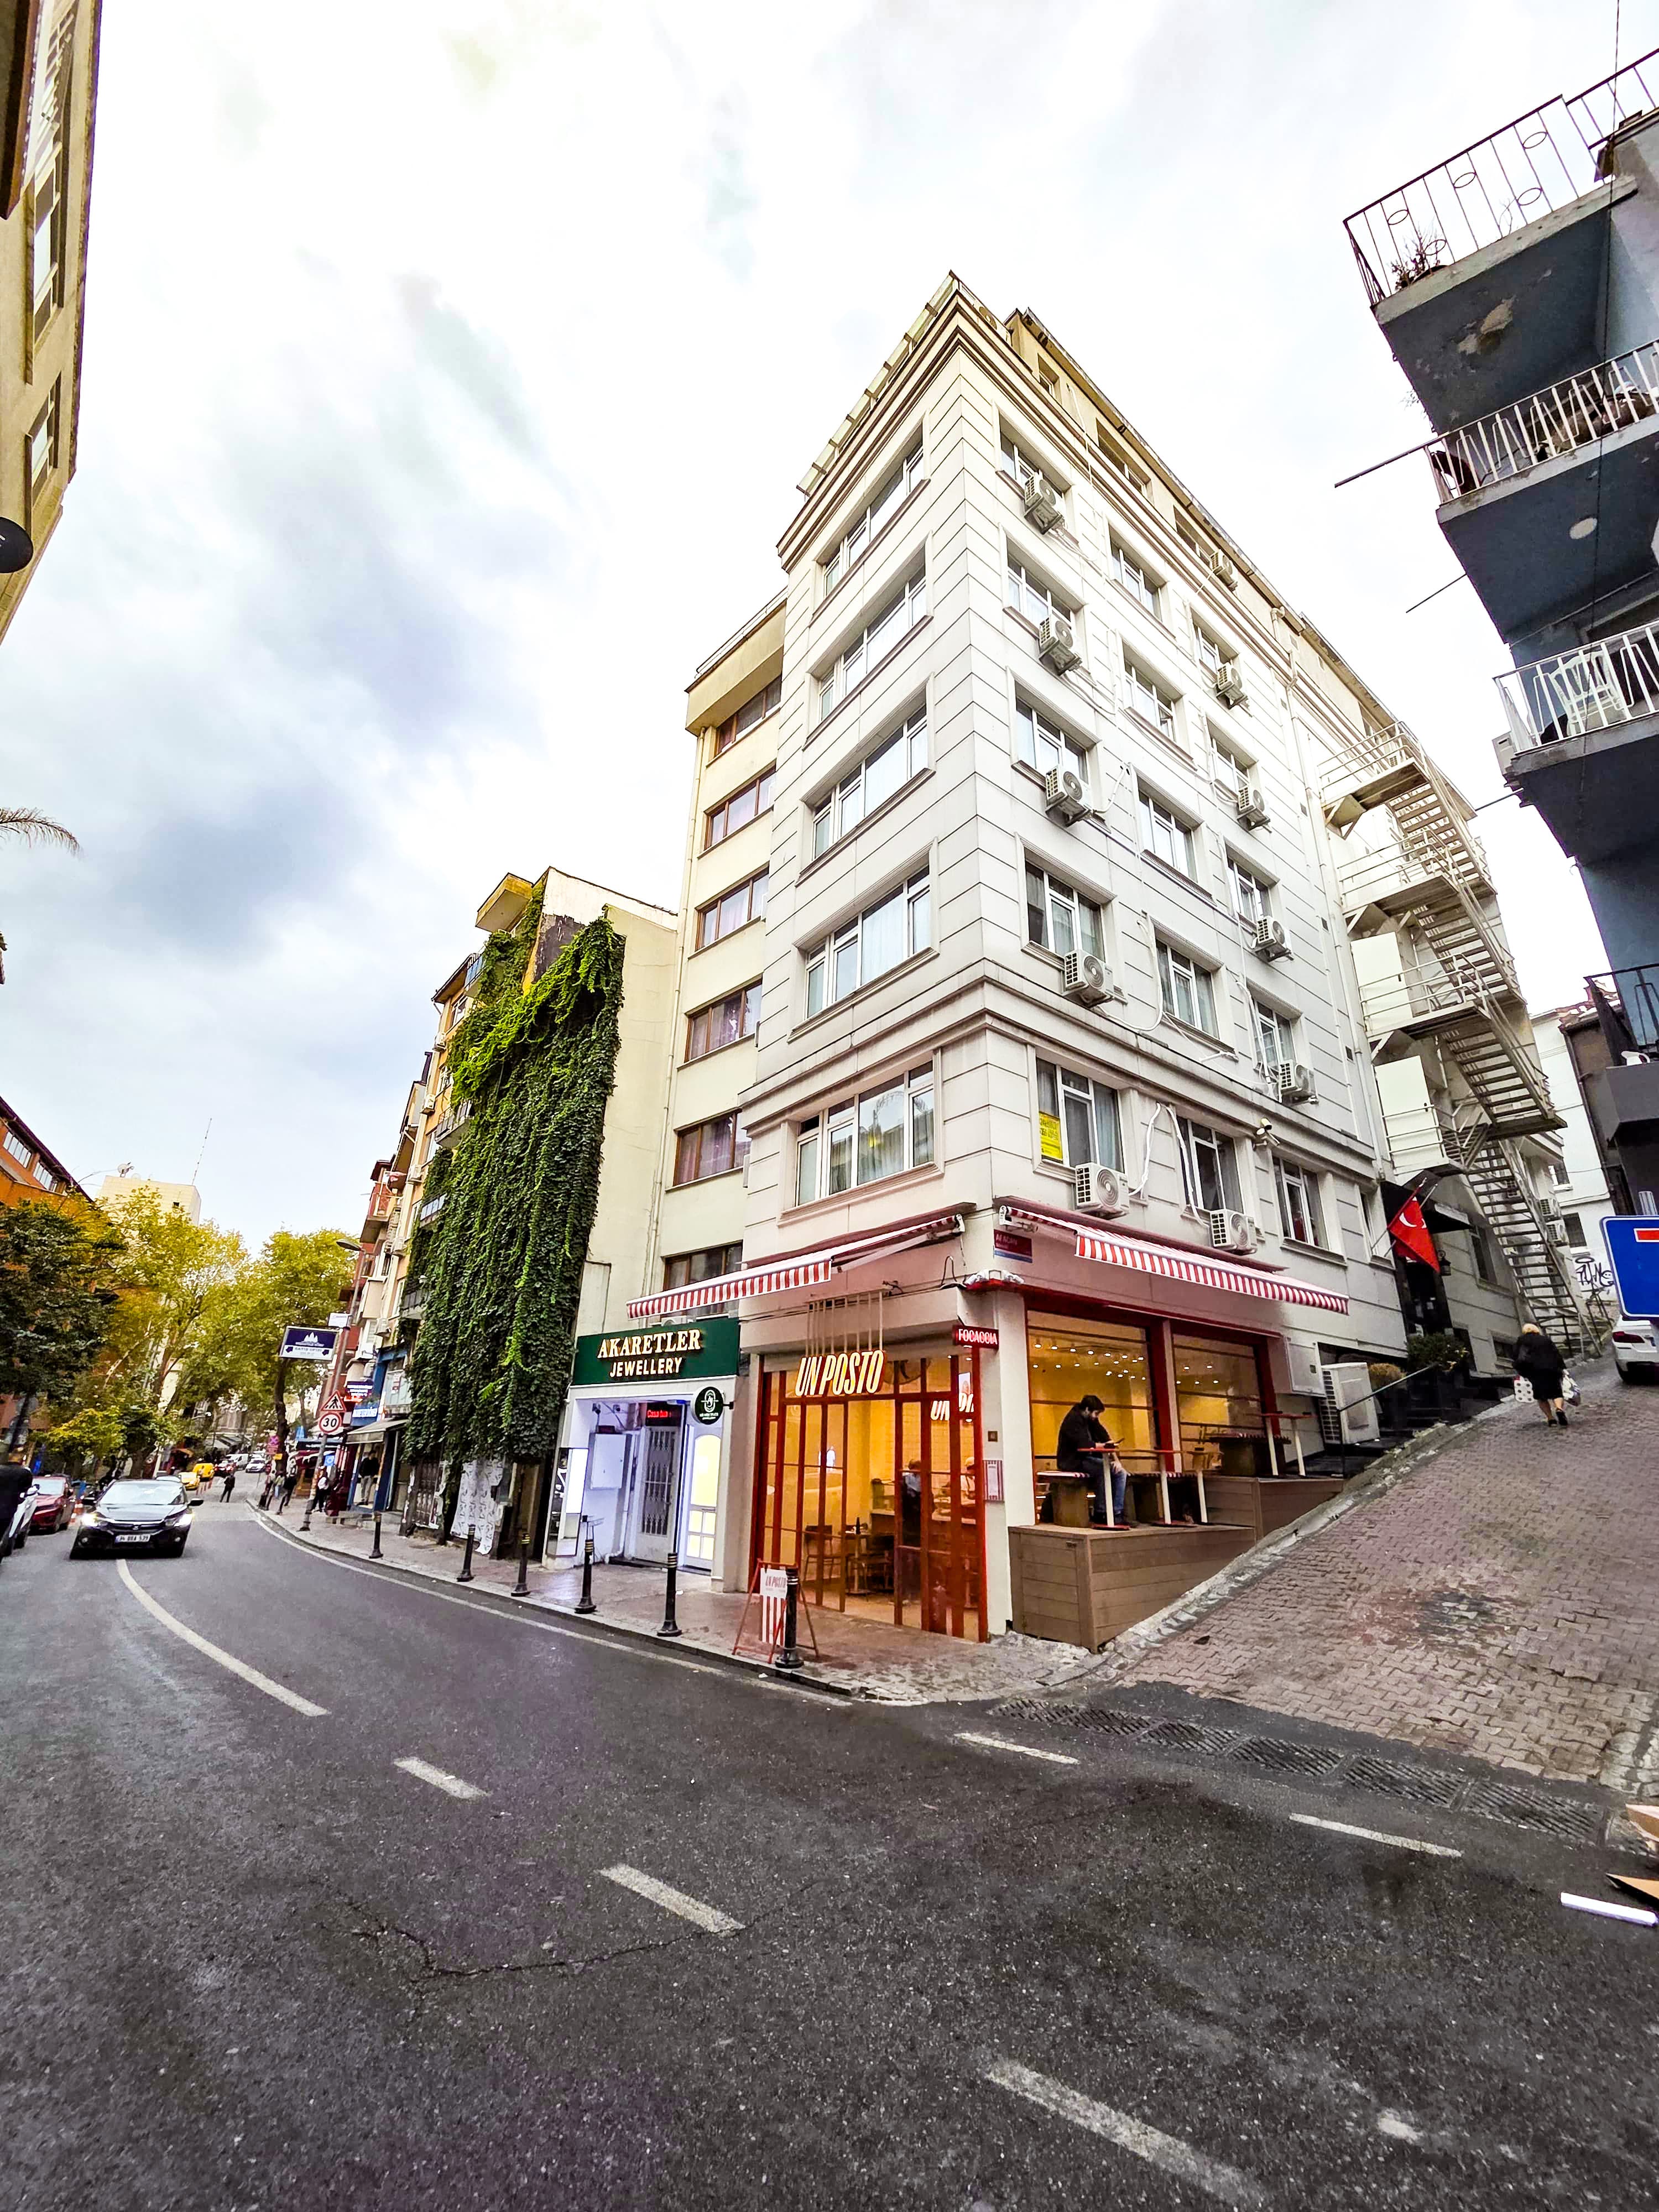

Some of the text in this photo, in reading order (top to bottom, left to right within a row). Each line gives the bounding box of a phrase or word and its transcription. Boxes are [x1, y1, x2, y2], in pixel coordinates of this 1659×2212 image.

[597, 1329, 701, 1358] AKARETLER
[958, 1328, 998, 1345] FOCACCIA
[609, 1357, 682, 1378] JEWELLERY
[795, 1350, 884, 1396] UN POSTO
[323, 1418, 337, 1427] 30
